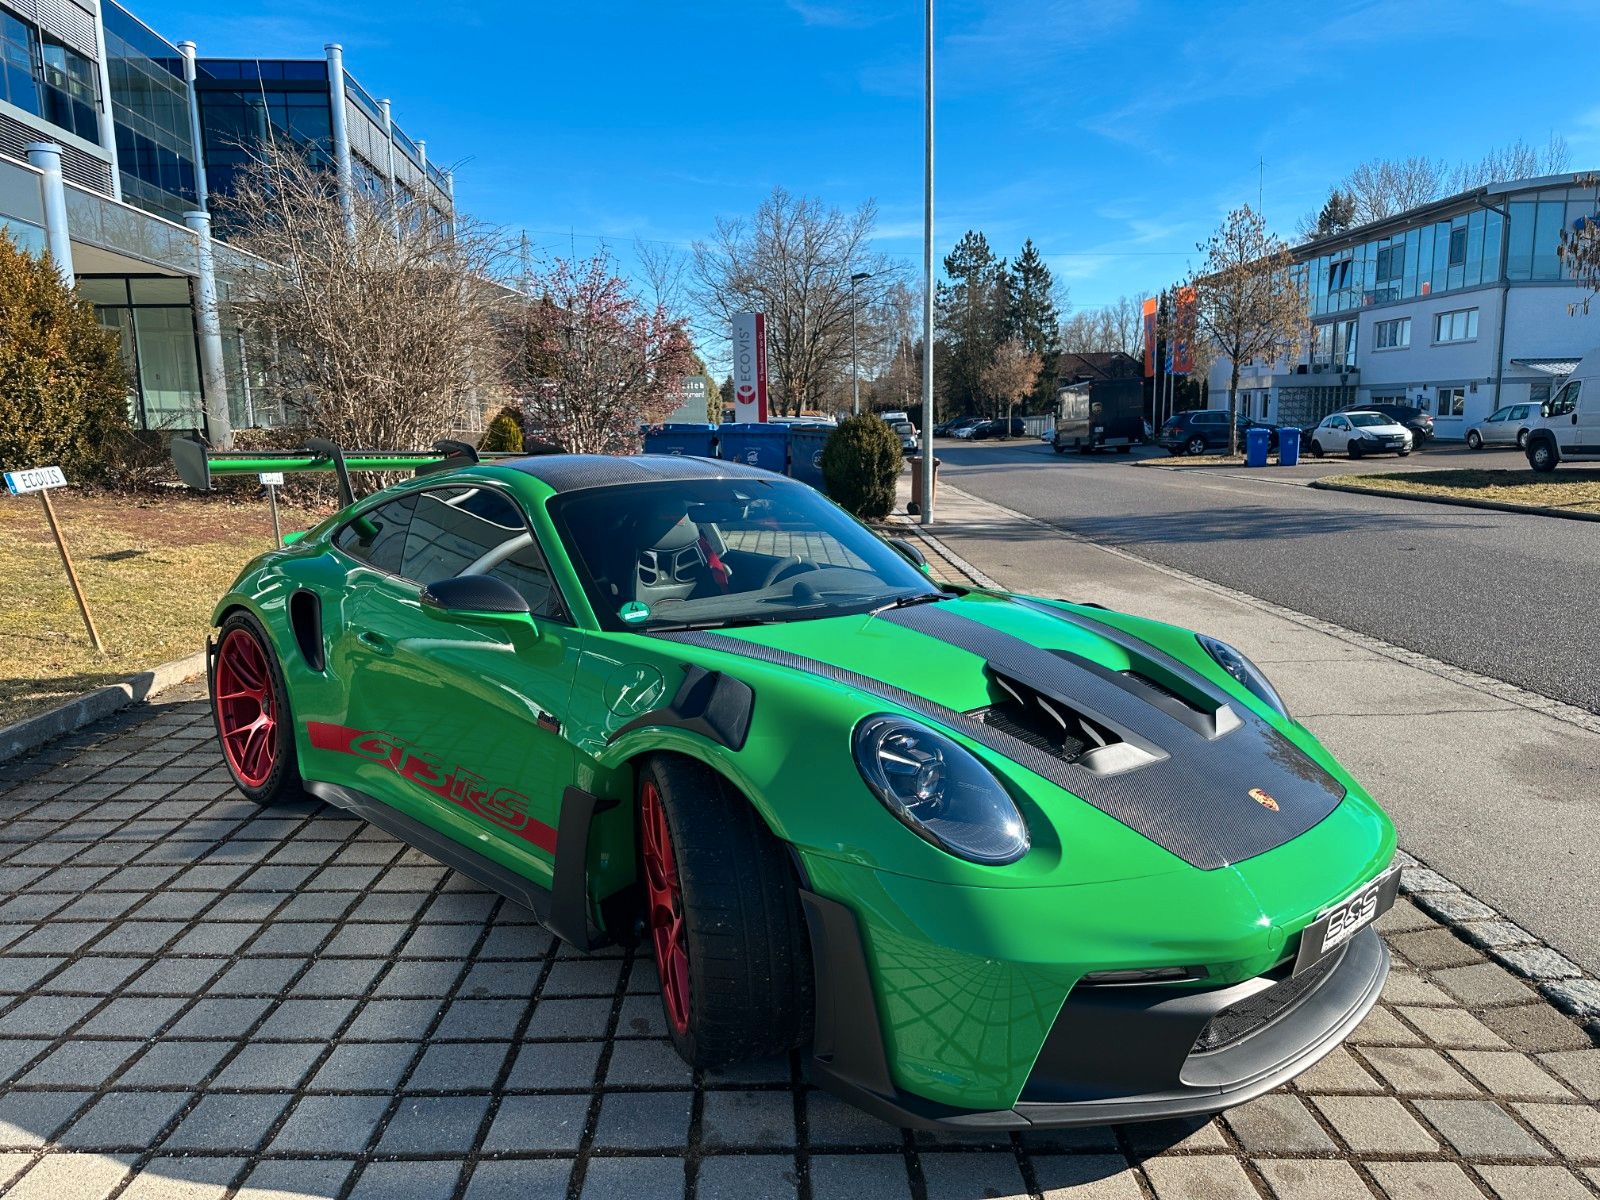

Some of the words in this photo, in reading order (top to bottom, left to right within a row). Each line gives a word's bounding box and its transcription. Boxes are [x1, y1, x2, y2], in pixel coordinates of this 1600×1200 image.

[740, 331, 752, 382] ECOVIS
[20, 469, 60, 488] ECOVIS
[629, 601, 639, 612] 4
[1325, 885, 1379, 942] B&S
